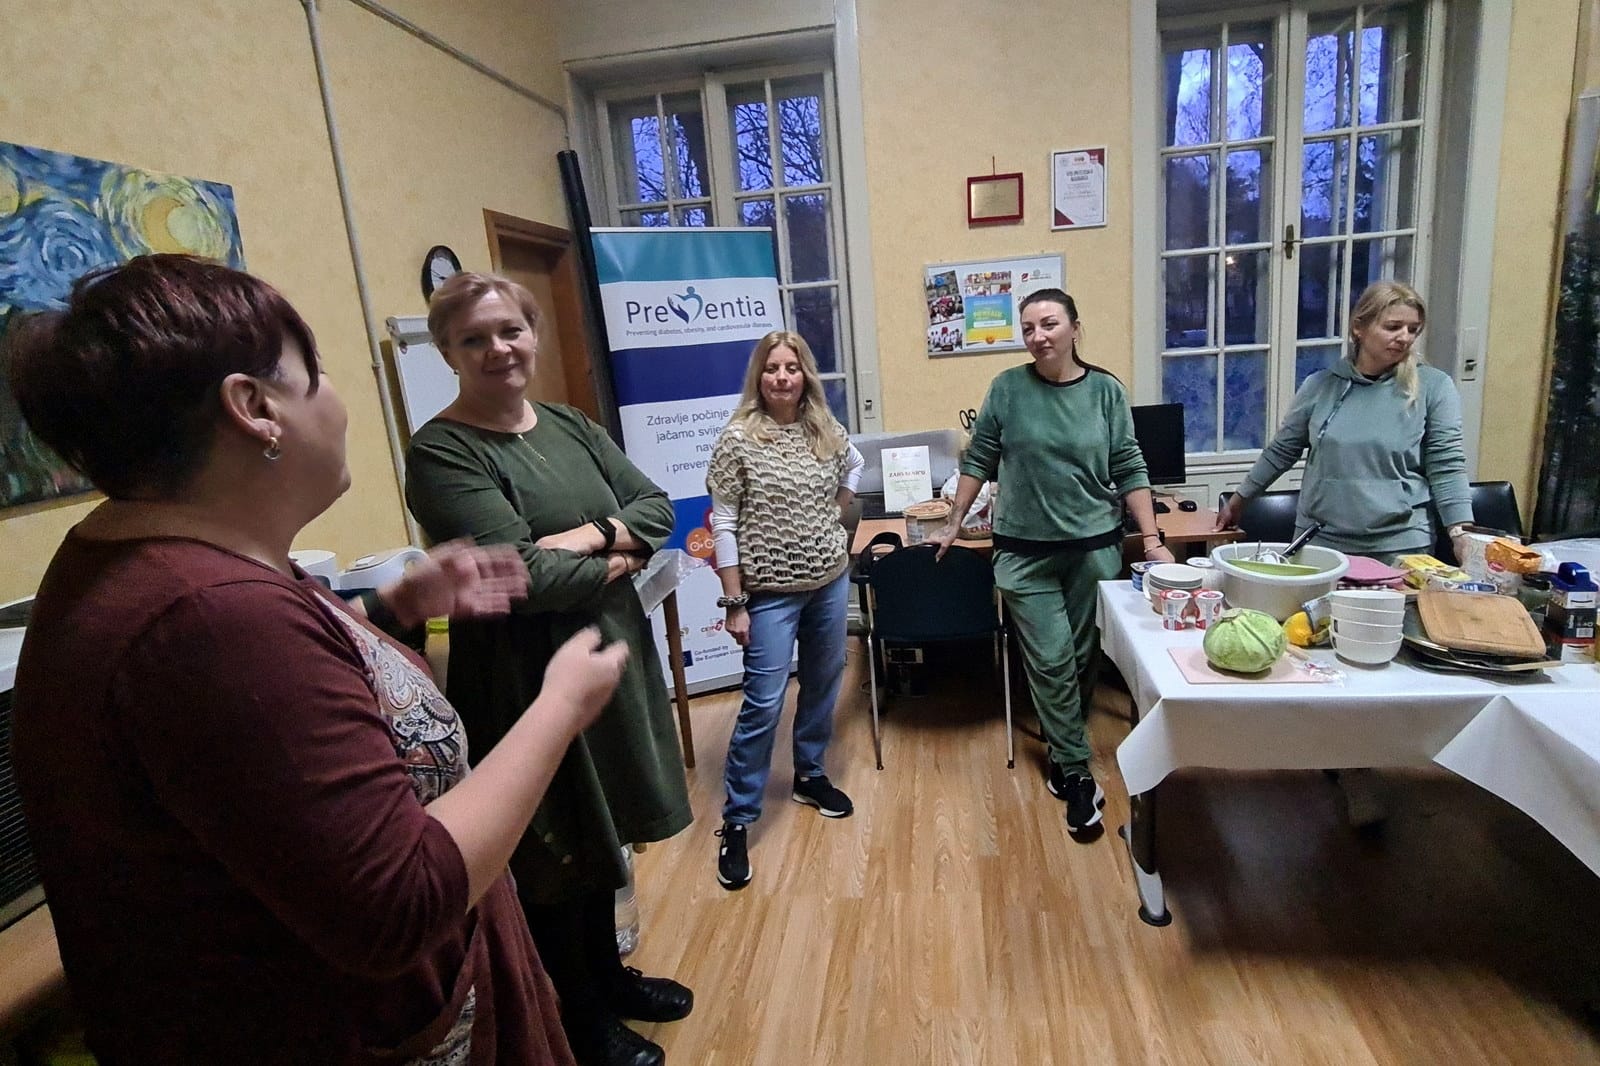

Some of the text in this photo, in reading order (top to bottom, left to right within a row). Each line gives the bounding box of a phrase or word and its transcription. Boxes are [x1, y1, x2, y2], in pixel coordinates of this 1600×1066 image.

[646, 408, 730, 426] Zdravlje počinje
[655, 429, 696, 444] jačamo
